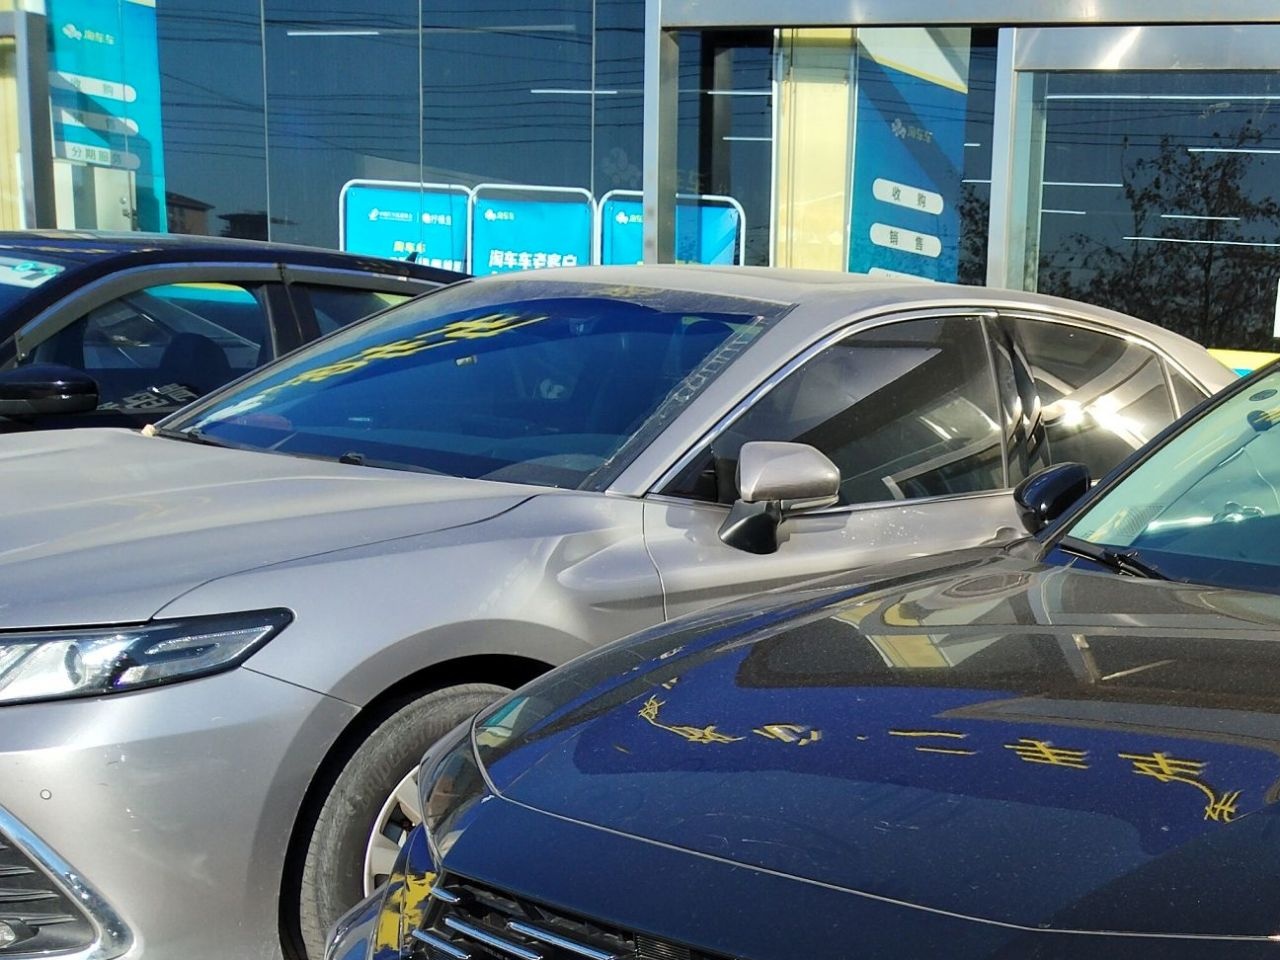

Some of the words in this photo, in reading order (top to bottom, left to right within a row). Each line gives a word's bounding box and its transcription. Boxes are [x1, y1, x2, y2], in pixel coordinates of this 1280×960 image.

[892, 186, 927, 208] 收购
[489, 249, 578, 269] 淘车车老客户
